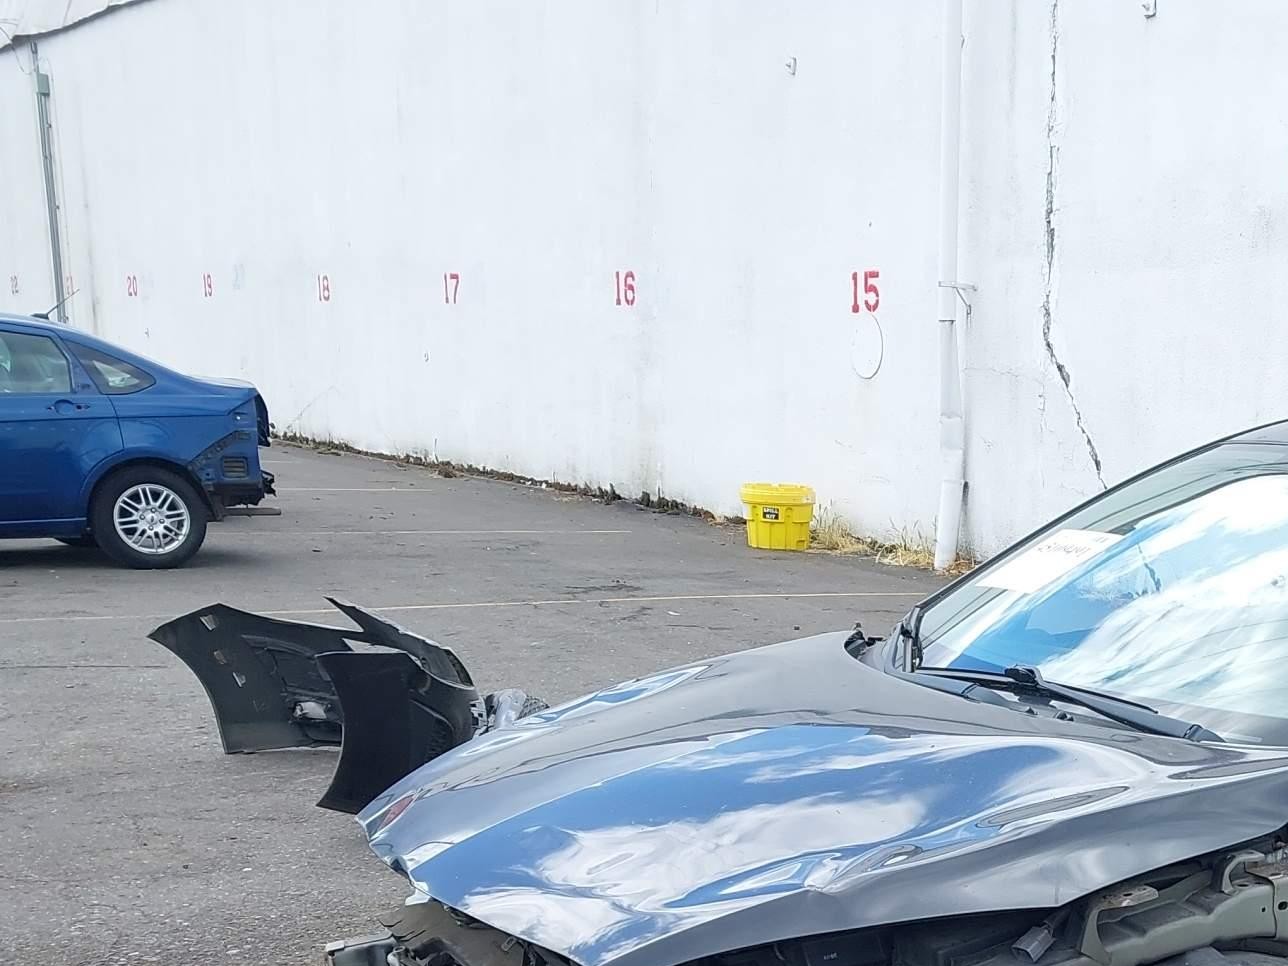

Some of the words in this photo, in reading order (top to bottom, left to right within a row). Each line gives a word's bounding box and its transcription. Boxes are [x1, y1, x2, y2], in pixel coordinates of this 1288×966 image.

[127, 275, 138, 297] 20
[203, 274, 213, 297] 19
[317, 275, 331, 301] 18
[443, 273, 460, 304] 17
[615, 270, 636, 306] 16
[851, 270, 880, 313] 15
